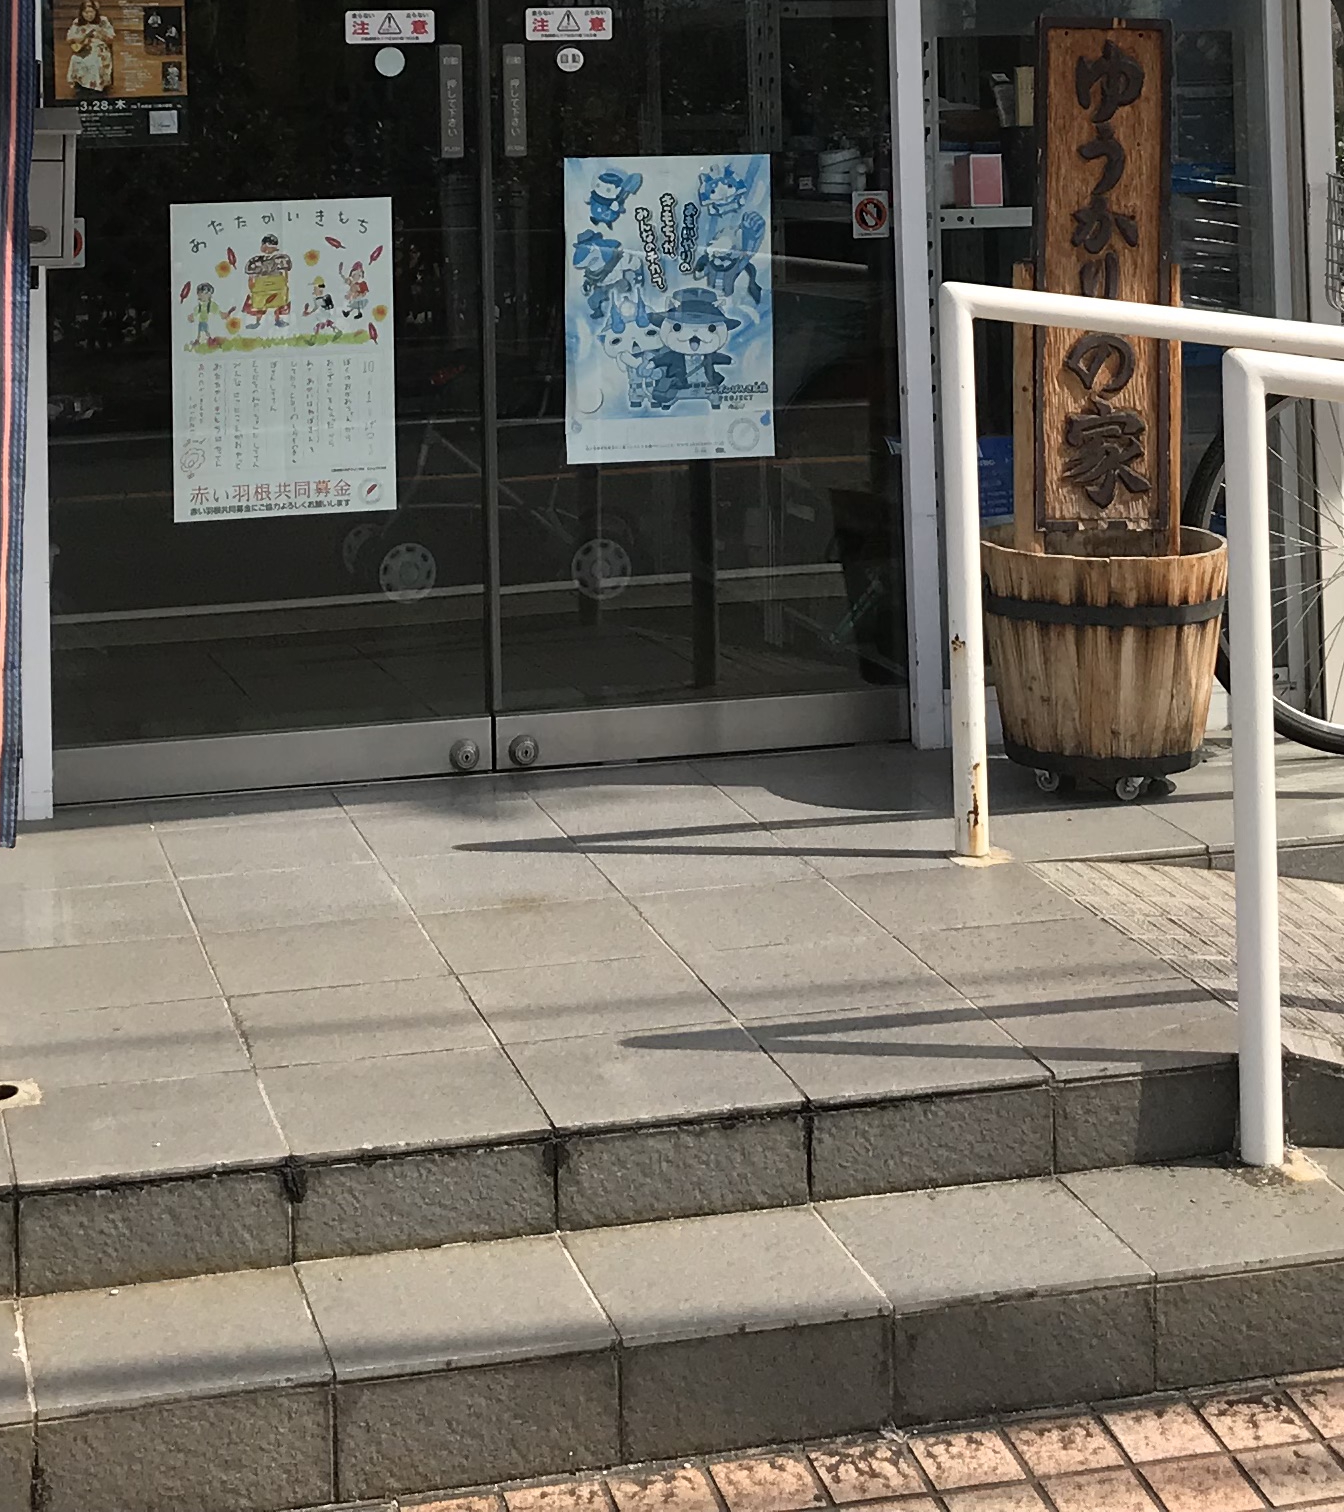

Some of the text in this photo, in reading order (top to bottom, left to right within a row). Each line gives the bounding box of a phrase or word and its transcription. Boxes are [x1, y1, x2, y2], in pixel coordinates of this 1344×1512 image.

[190, 478, 352, 506] 赤い羽根共同募金
